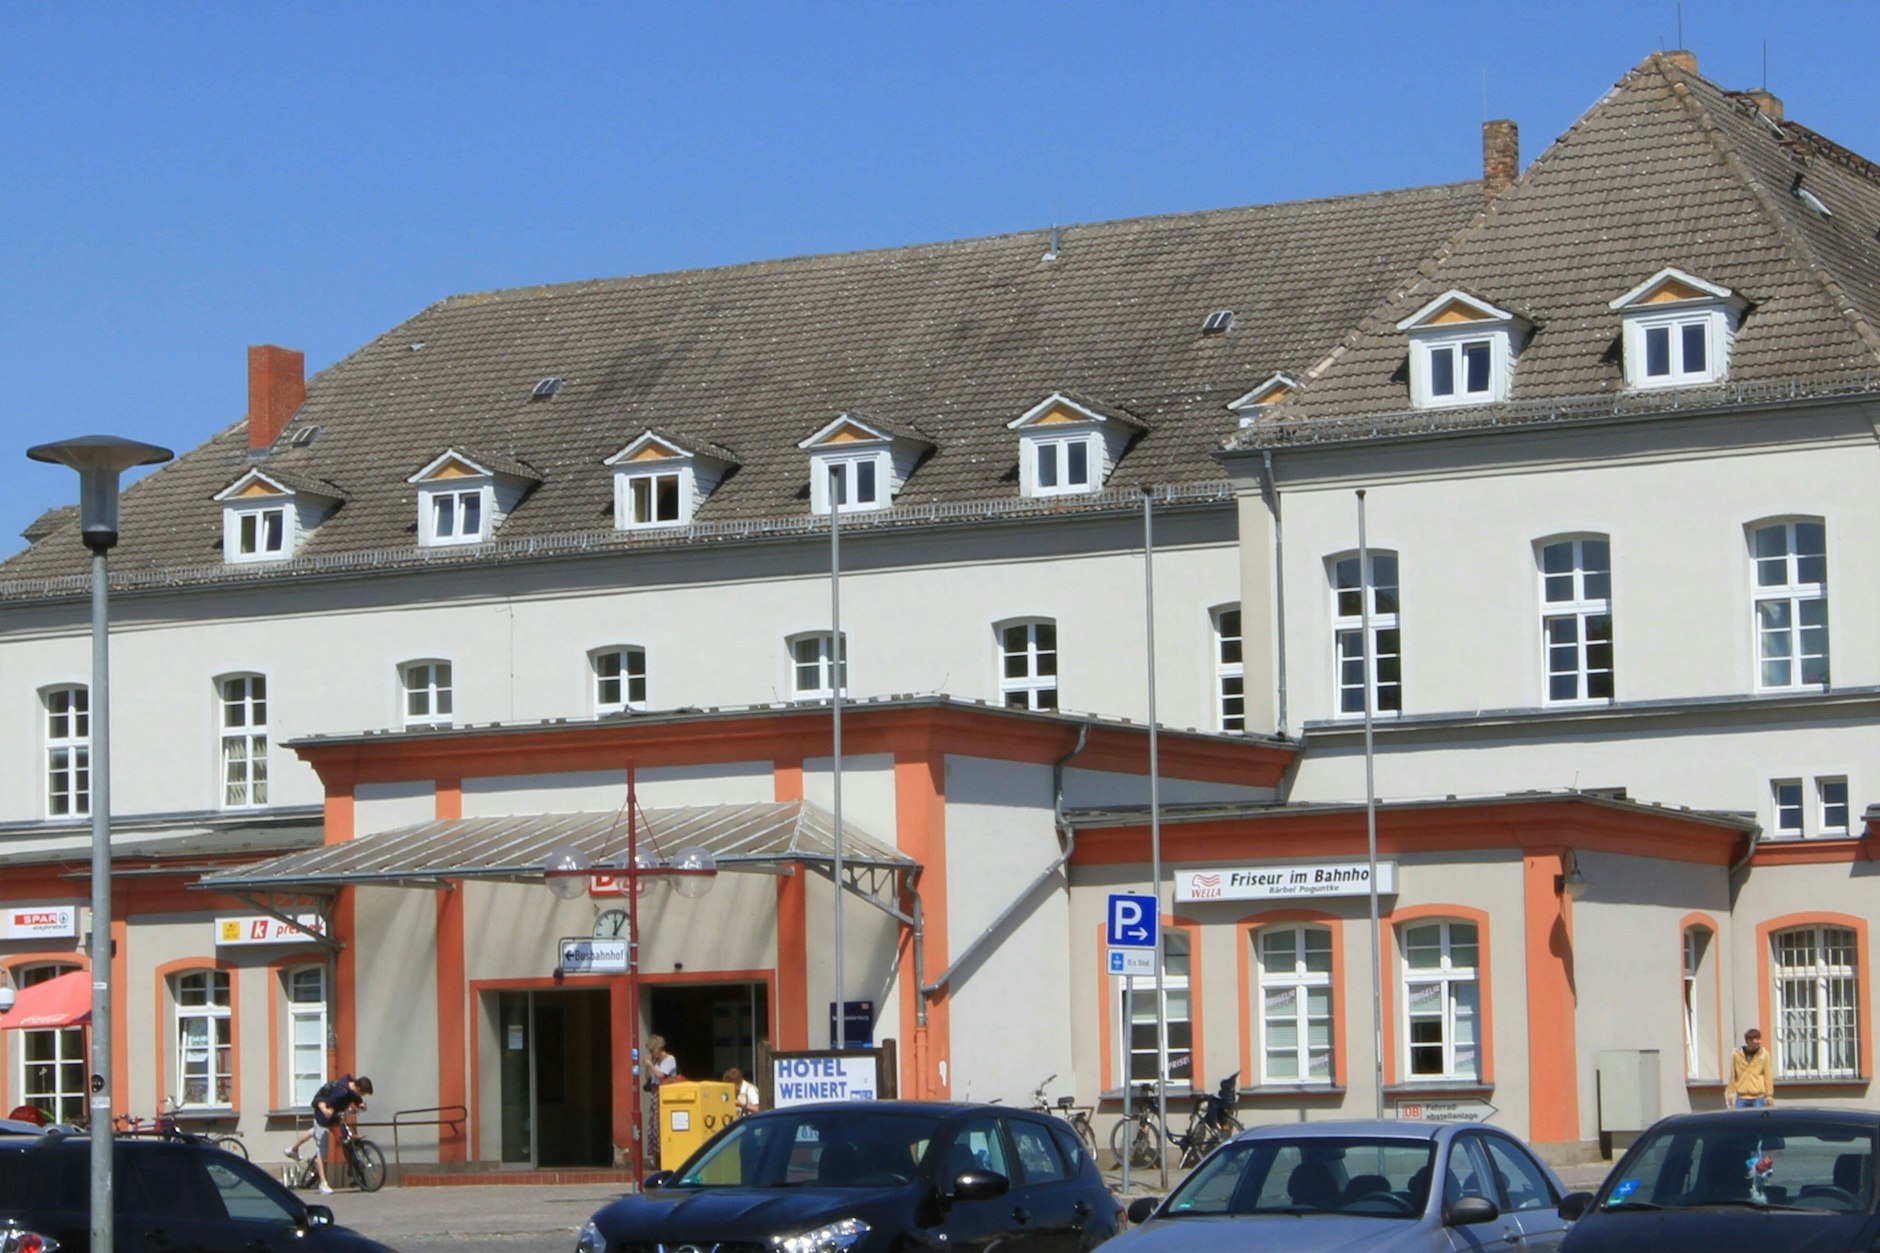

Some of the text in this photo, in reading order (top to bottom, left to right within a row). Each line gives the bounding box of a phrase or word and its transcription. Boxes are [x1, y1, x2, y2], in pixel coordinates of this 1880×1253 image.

[1231, 867, 1370, 887] Friseur im Bahnho
[1191, 888, 1222, 898] WELLA
[1269, 884, 1340, 894] Bärbel Poguntke
[23, 914, 57, 925] SPAR
[1115, 900, 1143, 940] P
[575, 949, 624, 961] Busbahnhof
[778, 1057, 847, 1078] HOTEL
[780, 1082, 847, 1099] WEINERT
[1404, 1106, 1420, 1117] DB
